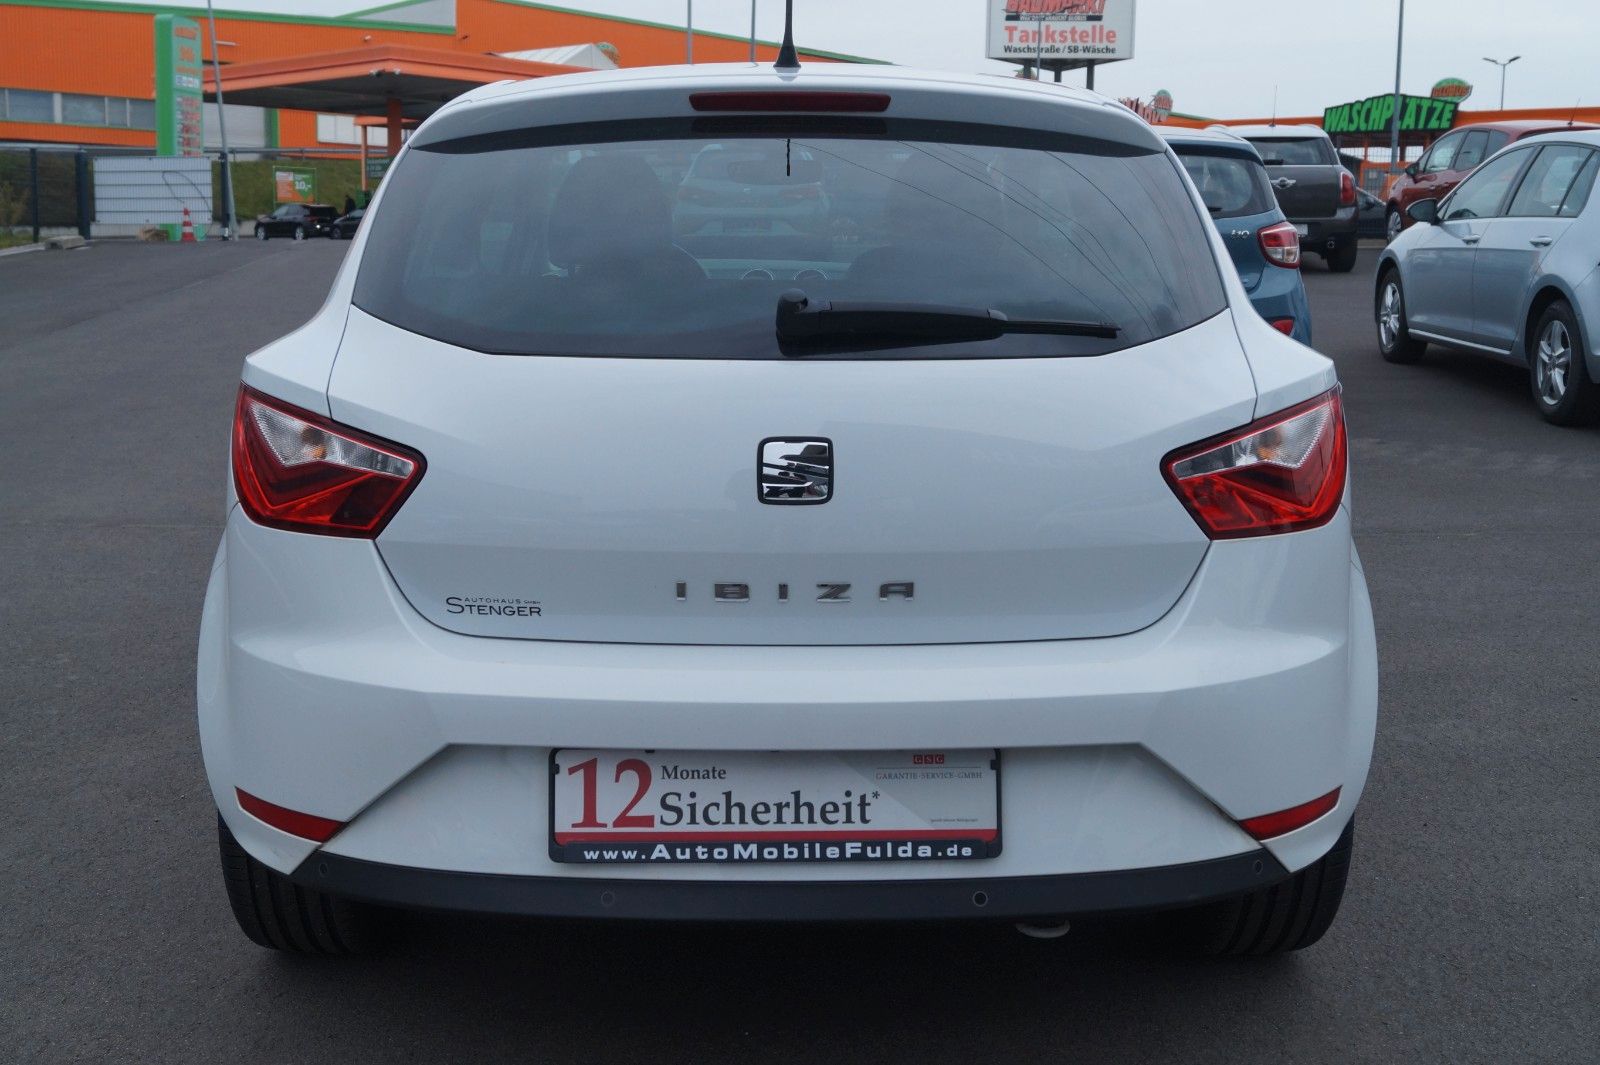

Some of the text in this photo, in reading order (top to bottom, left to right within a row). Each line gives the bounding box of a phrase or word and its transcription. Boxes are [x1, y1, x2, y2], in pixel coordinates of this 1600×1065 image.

[1004, 24, 1117, 44] Tankstelle
[1004, 45, 1060, 54] Waschsraße
[464, 596, 521, 605] AUTOHAUS
[676, 582, 914, 602] IBIZA
[446, 596, 541, 616] STENGER
[912, 753, 945, 765] GSG
[660, 764, 727, 780] Monate
[567, 757, 655, 829] 12
[583, 842, 973, 861] www.AutoMobileFulda.de
